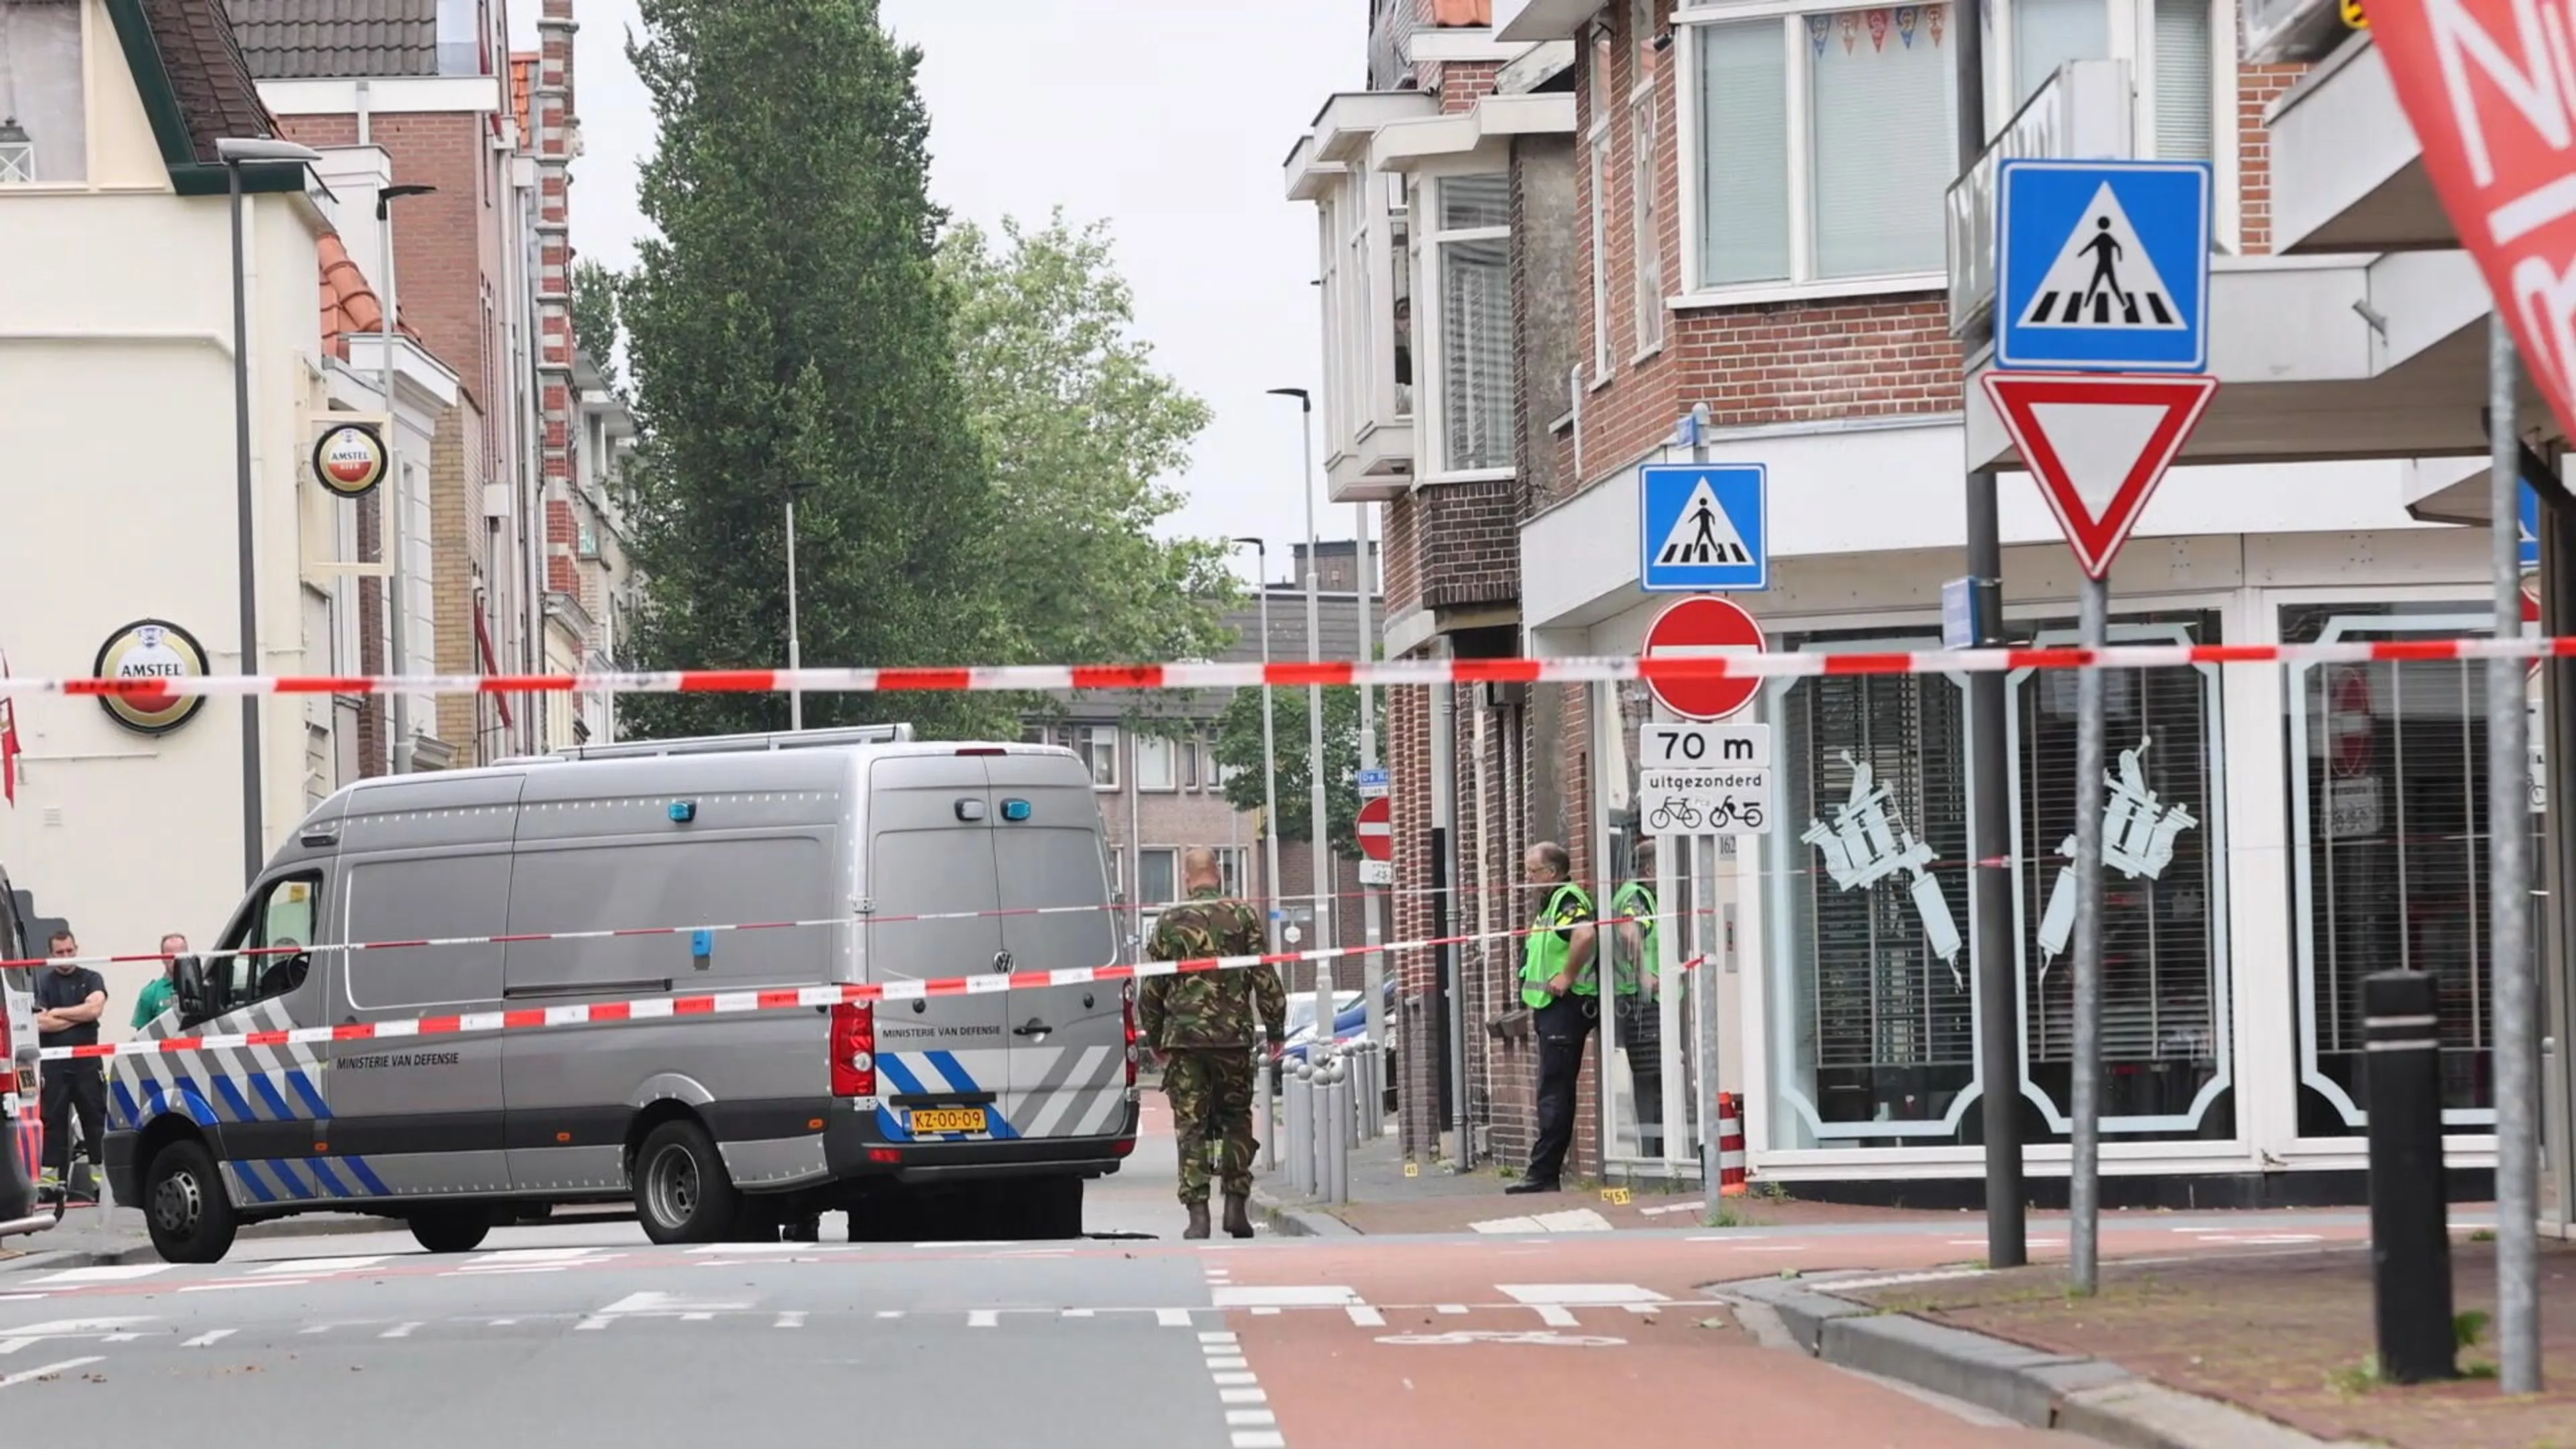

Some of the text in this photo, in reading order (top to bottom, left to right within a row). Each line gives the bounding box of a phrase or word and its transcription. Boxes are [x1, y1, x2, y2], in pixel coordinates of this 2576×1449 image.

[331, 451, 368, 460] AMSTEL
[121, 663, 182, 677] AMSTEL
[1658, 732, 1754, 759] 70 m
[1650, 774, 1762, 792] uitgezonderd
[1719, 835, 1737, 854] 162
[883, 1025, 1000, 1039] MINISTERIE VAN DEFENSIE
[337, 1052, 460, 1070] MINISTERIE VAN DEFENSIE
[915, 1111, 981, 1128] KZ-00-09
